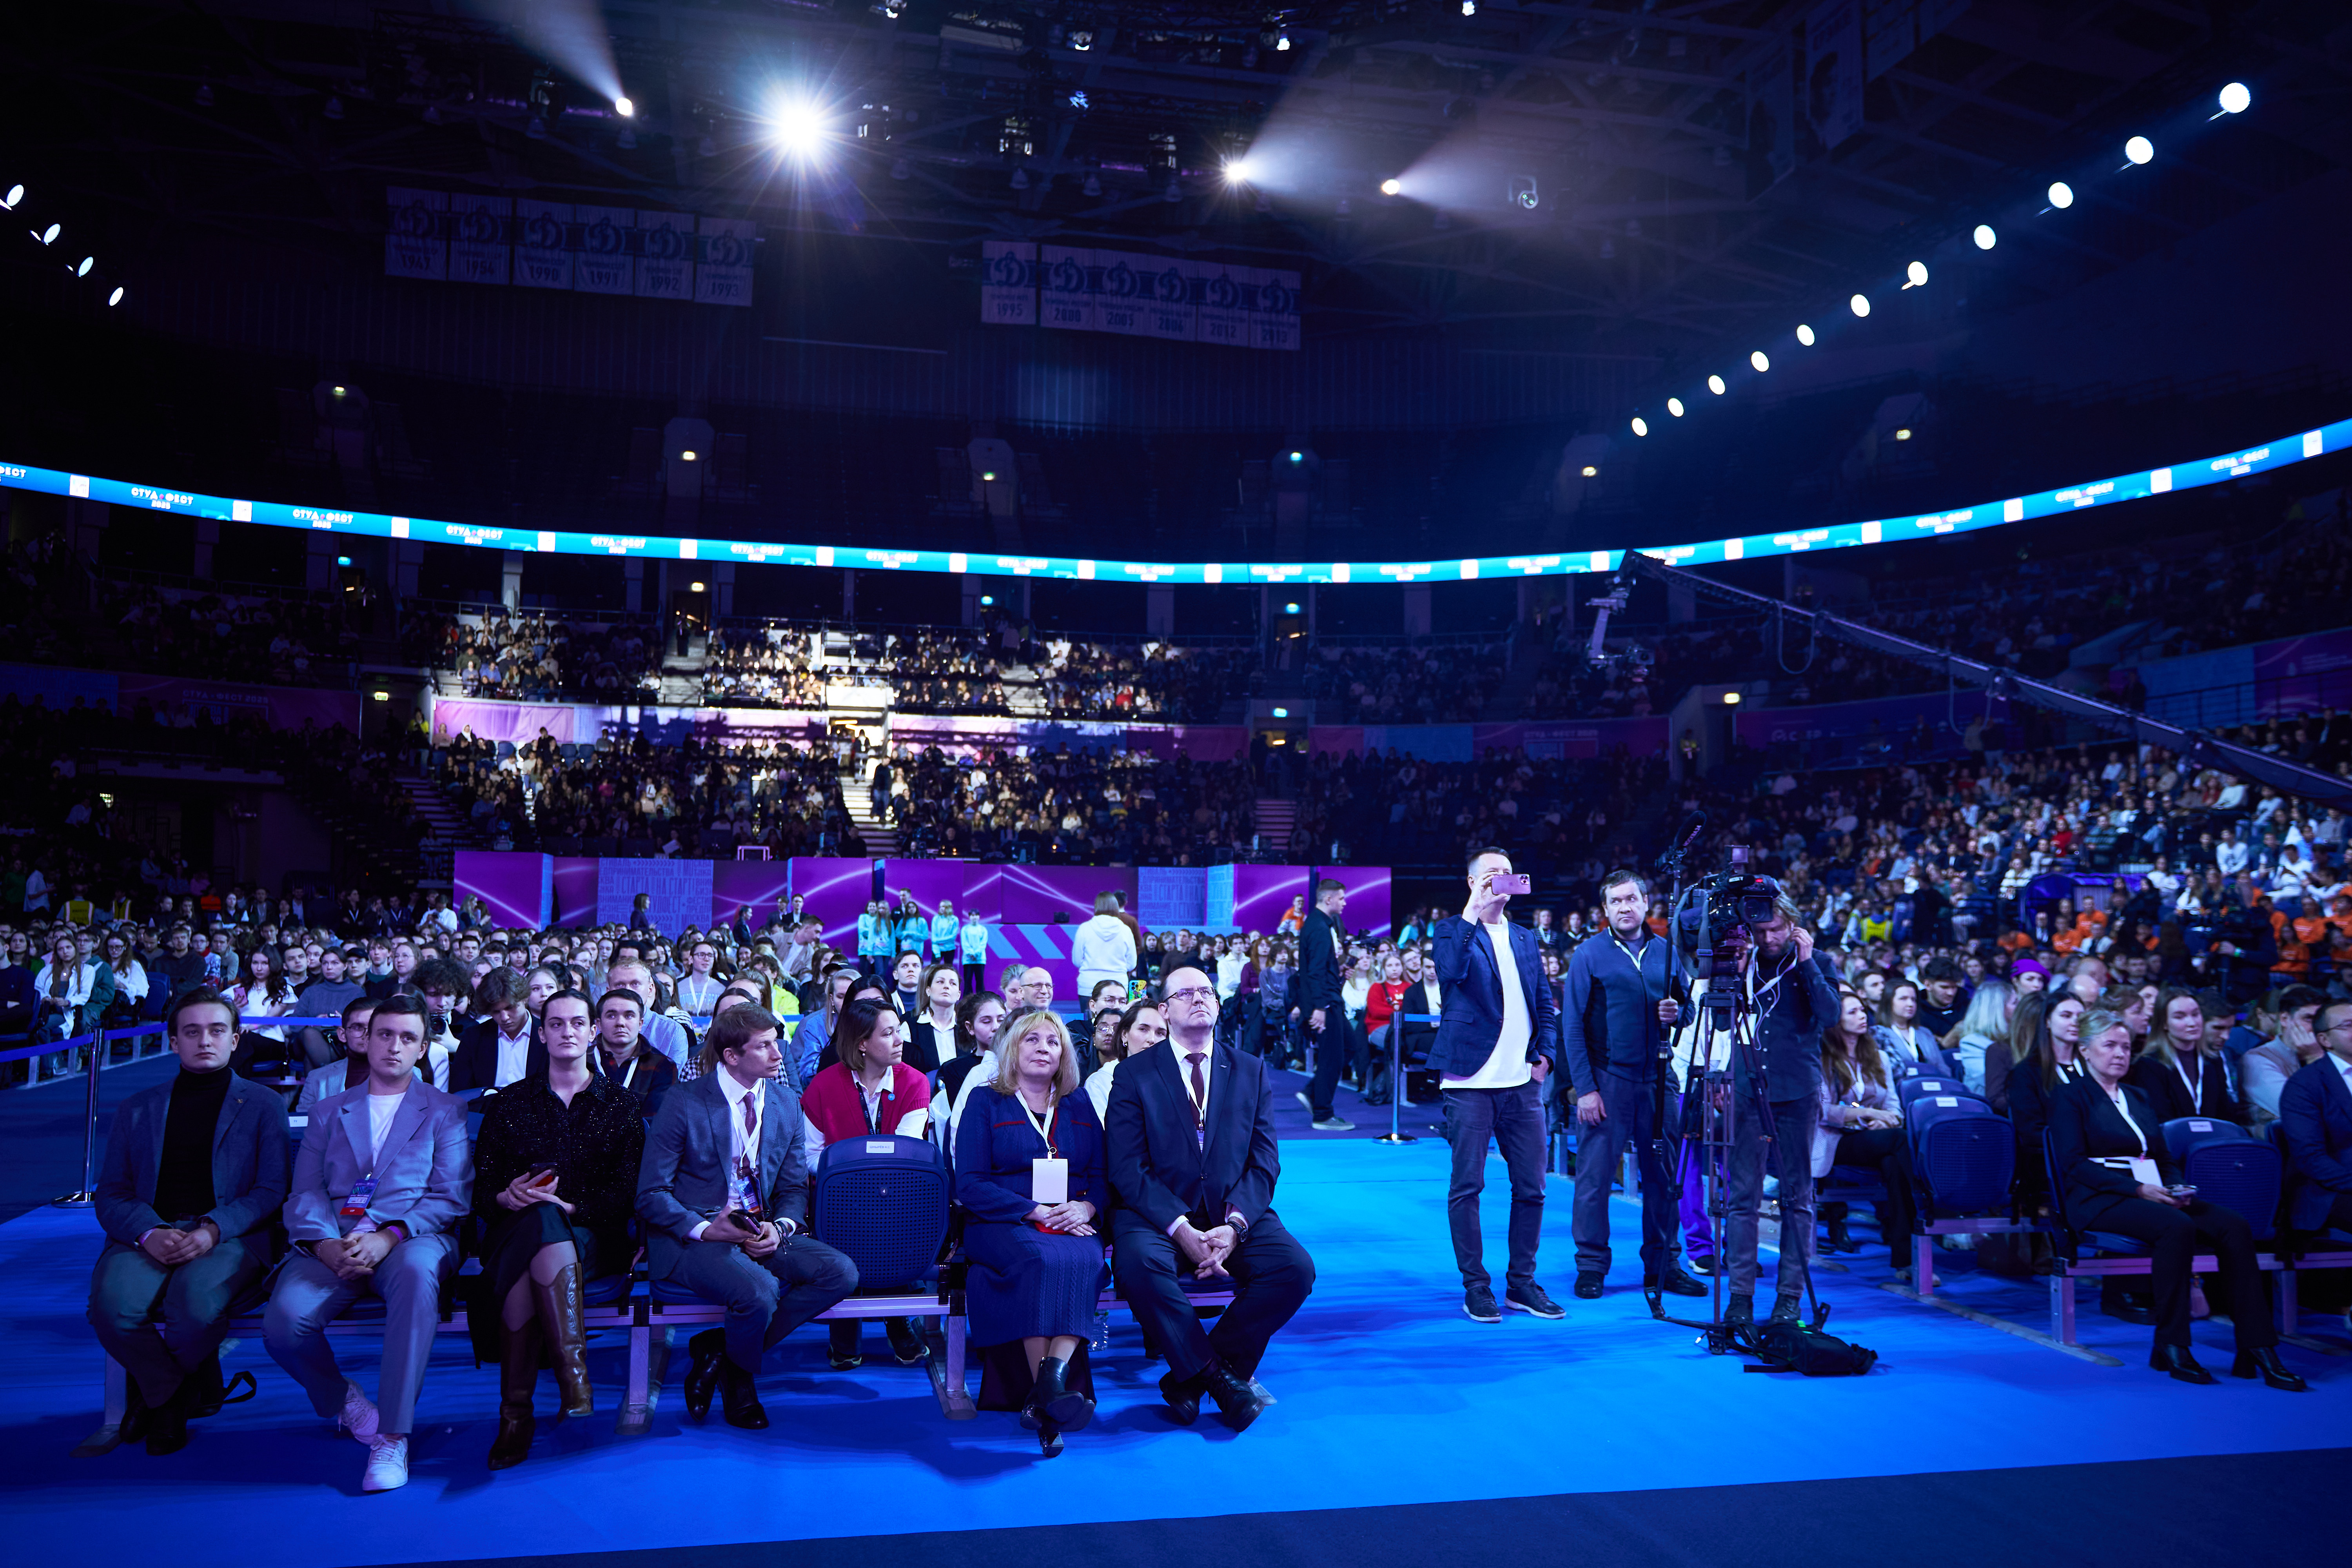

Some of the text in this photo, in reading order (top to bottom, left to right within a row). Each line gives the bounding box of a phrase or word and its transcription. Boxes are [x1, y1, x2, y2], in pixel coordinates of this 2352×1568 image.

[529, 265, 558, 281] 1990
[590, 270, 619, 285] 1991
[651, 276, 679, 290] 1992
[711, 282, 739, 297] 1993
[997, 303, 1023, 317] 1995
[1054, 308, 1081, 323] 2000
[1107, 312, 1134, 327] 2005
[1210, 323, 1236, 338] 2012
